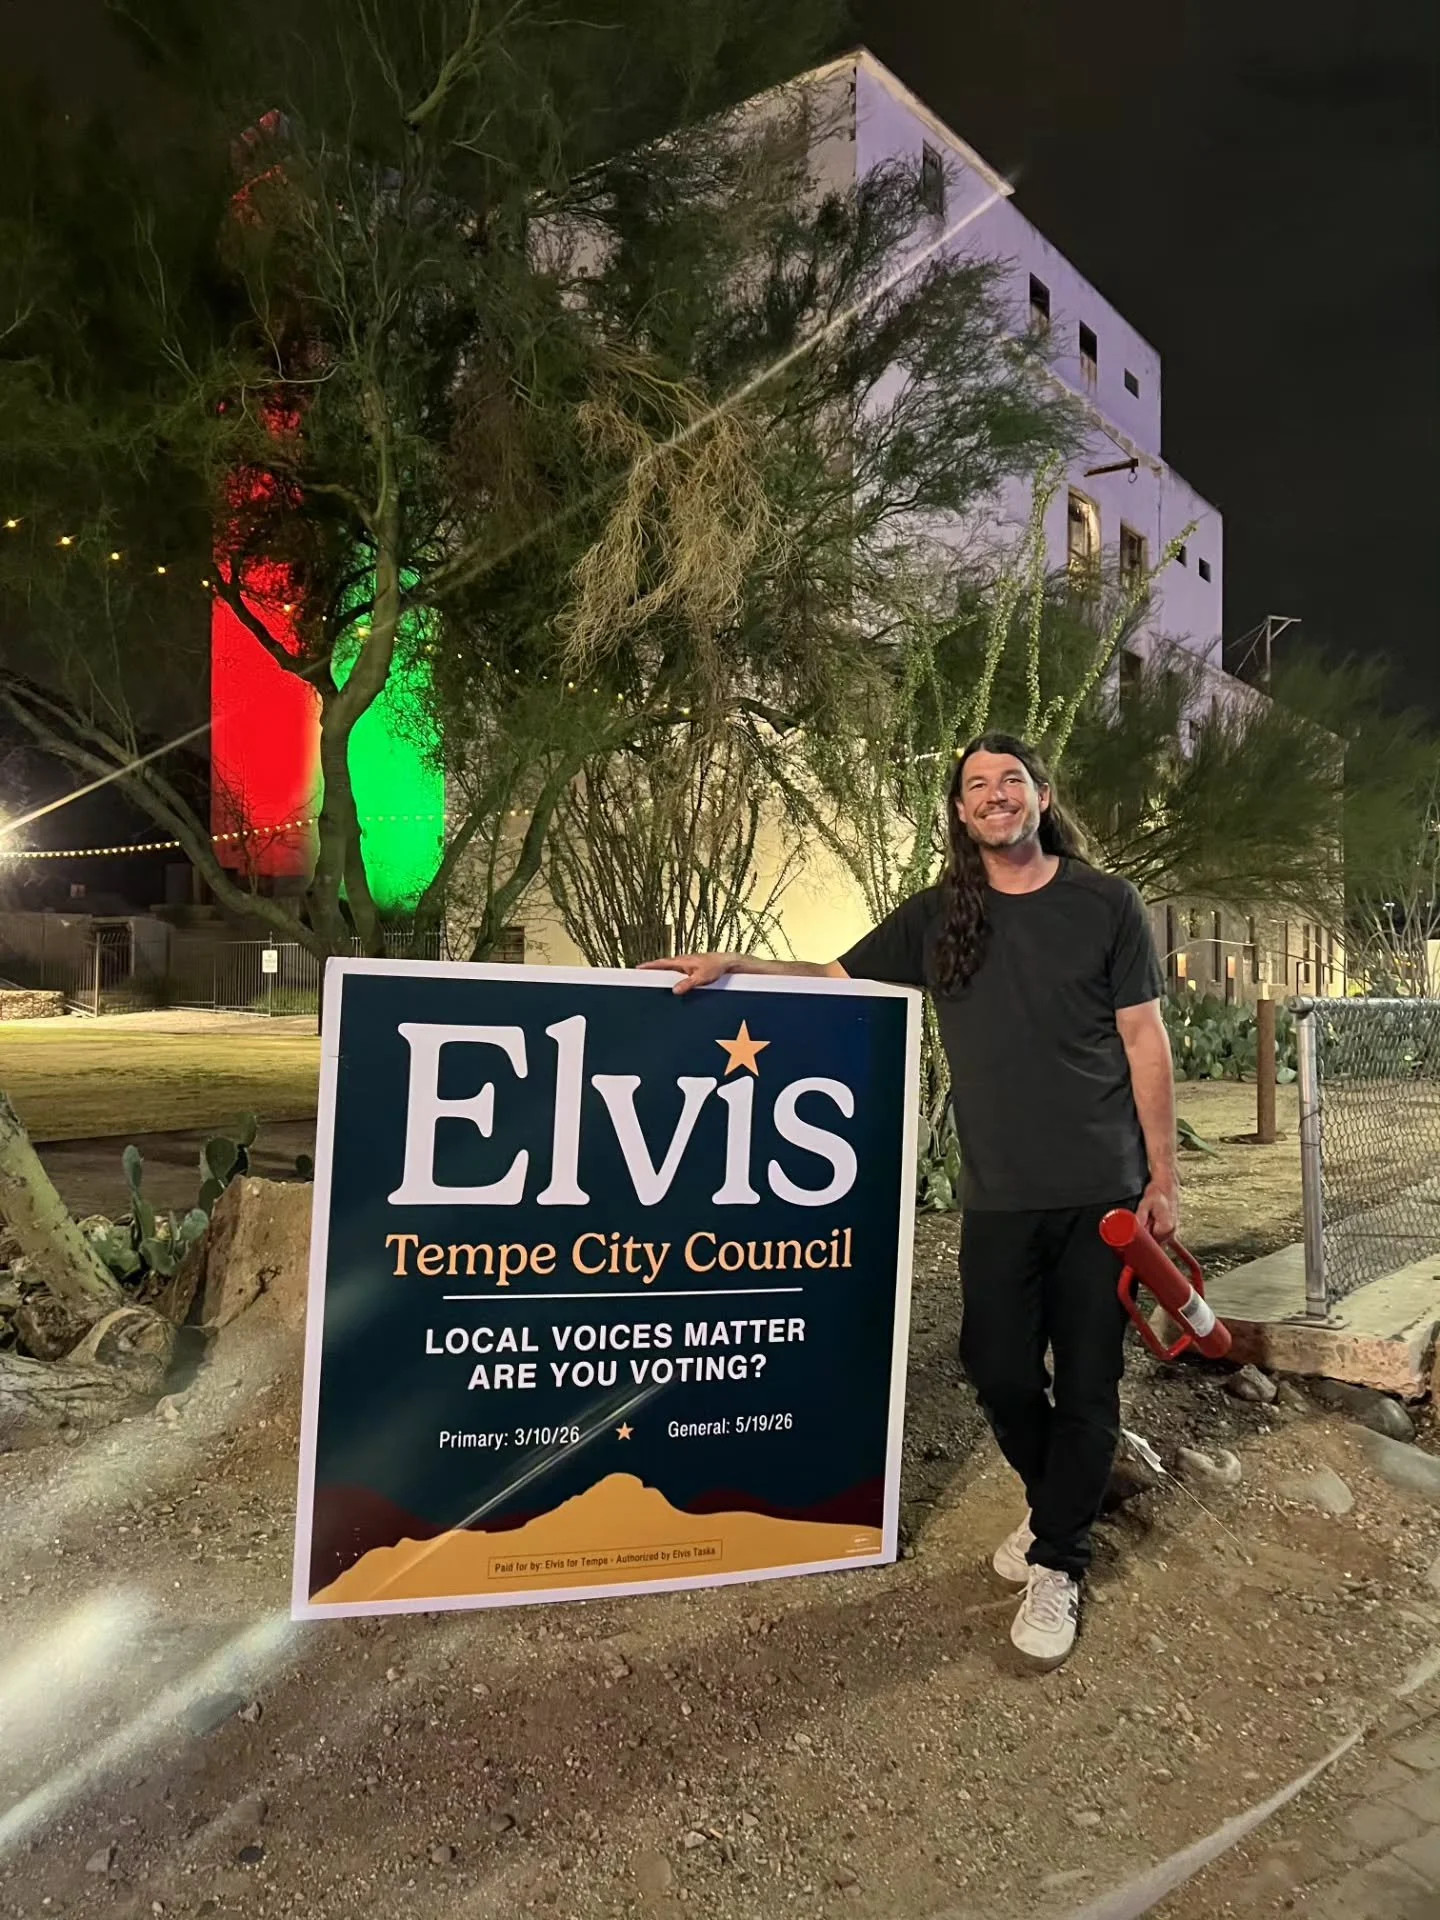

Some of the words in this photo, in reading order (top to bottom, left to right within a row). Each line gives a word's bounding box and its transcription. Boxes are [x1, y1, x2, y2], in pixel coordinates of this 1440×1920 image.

[388, 1015, 857, 1206] Elvis
[386, 1233, 555, 1285] Tempe
[573, 1232, 670, 1284] City
[685, 1228, 851, 1273] Council
[426, 1327, 538, 1354] LOCAL
[552, 1323, 672, 1350] VOICES
[685, 1318, 805, 1347] MATTER
[468, 1364, 536, 1389] ARE
[550, 1361, 616, 1387] YOU
[630, 1354, 766, 1384] VOTING?
[439, 1431, 508, 1450] Primary:
[514, 1426, 580, 1446] 3/10/26
[668, 1420, 730, 1438] General:
[735, 1413, 793, 1433] 5/19/26
[495, 1563, 513, 1573] Paid
[516, 1562, 528, 1572] for
[530, 1561, 543, 1572] by:
[545, 1559, 565, 1569] Elvis
[566, 1558, 578, 1568] for
[581, 1557, 608, 1567] Tempe
[616, 1552, 659, 1563] Authorized
[661, 1552, 670, 1561] by
[673, 1549, 691, 1559] Elvis
